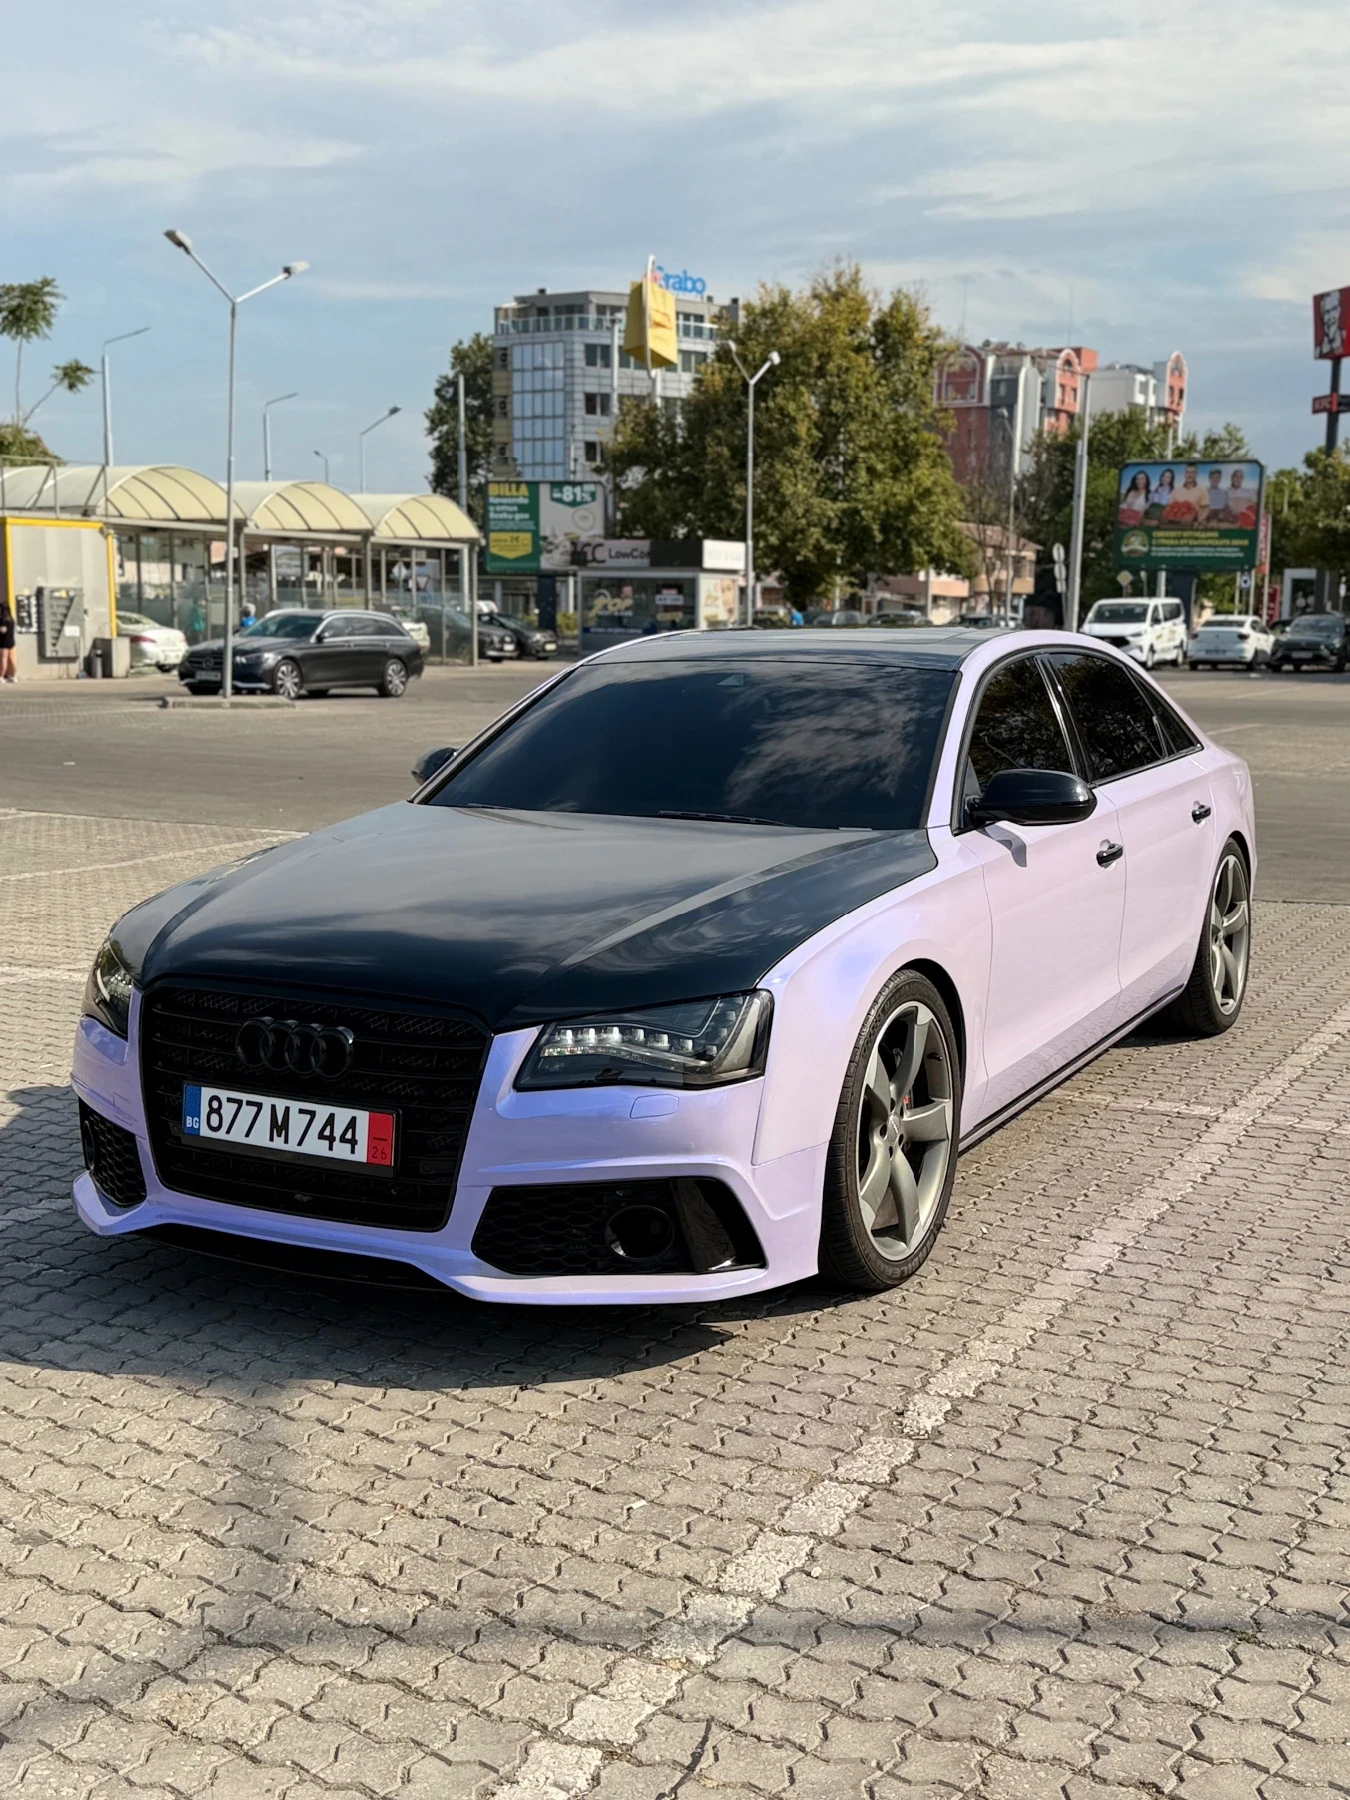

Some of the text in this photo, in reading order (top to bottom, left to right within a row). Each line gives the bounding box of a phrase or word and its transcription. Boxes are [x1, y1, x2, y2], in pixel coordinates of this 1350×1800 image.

[656, 266, 706, 294] rabo
[488, 482, 529, 496] BILLA
[186, 1115, 200, 1129] BG
[372, 1145, 387, 1160] 26
